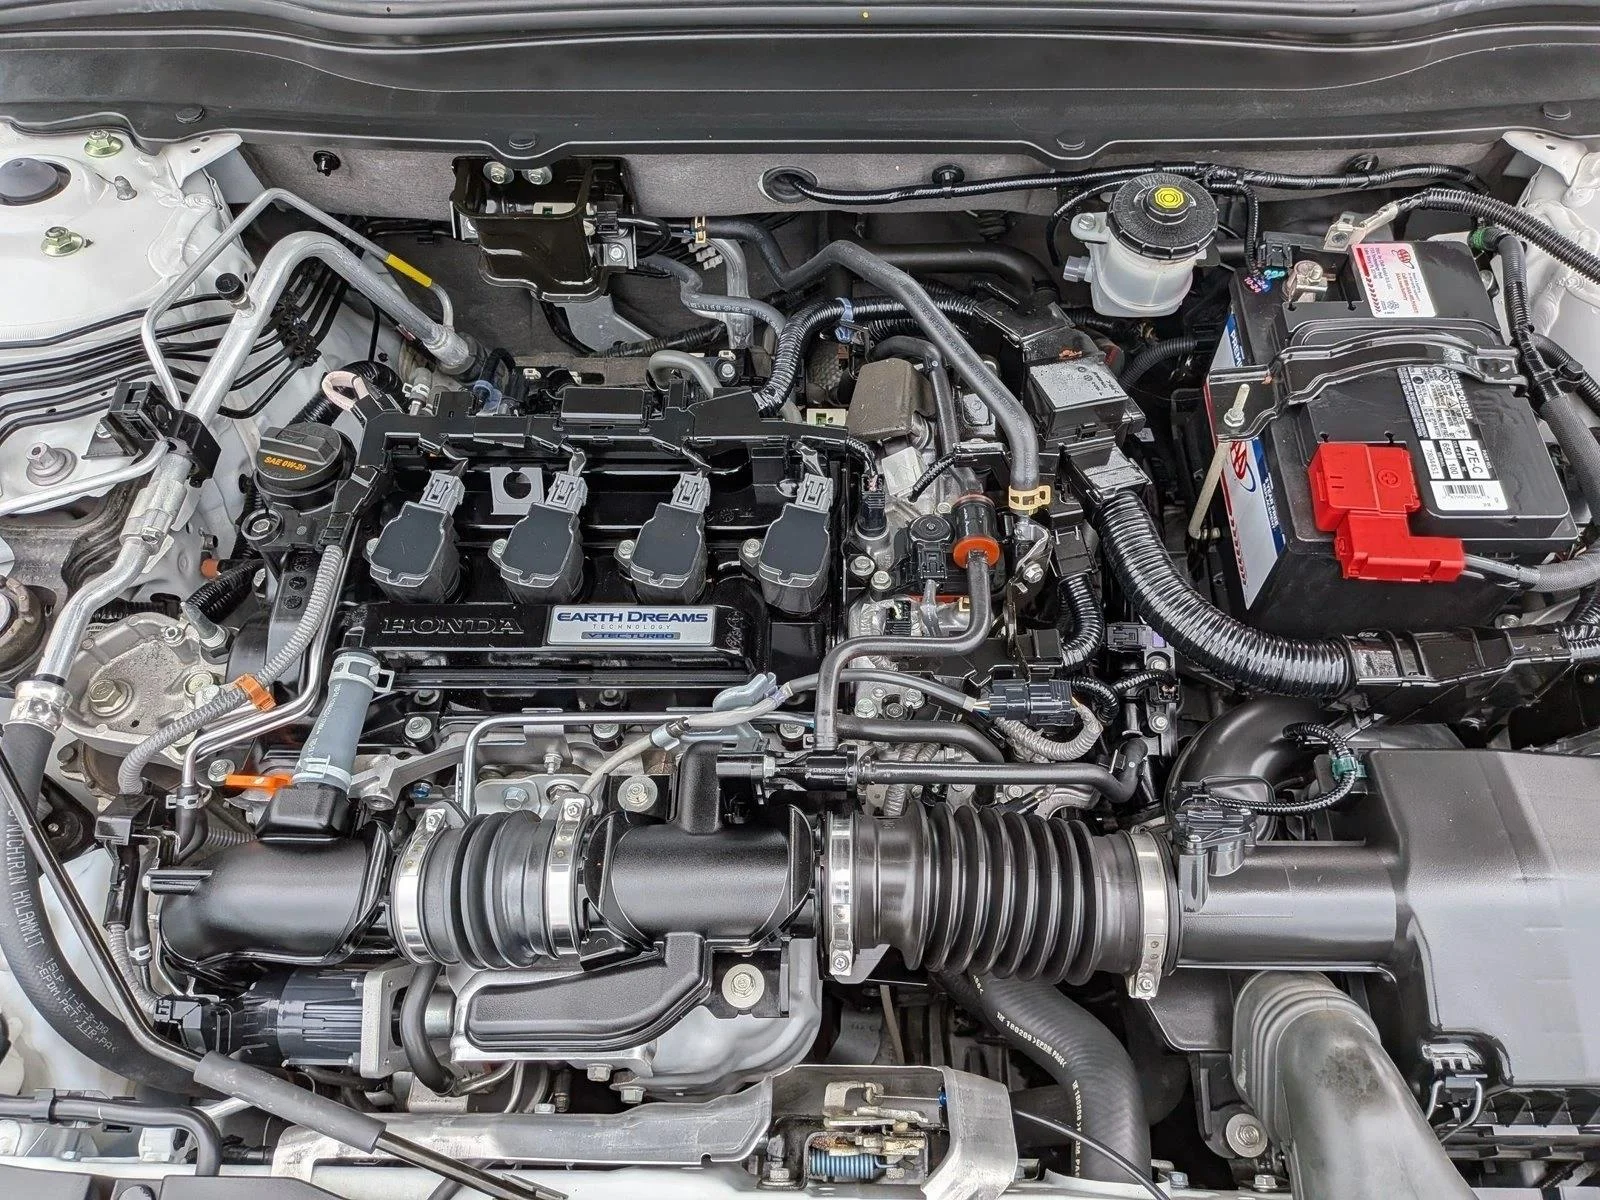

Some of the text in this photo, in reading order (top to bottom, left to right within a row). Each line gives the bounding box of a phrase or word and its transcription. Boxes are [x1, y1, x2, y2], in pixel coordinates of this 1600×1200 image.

[1442, 443, 1453, 456] 650
[264, 456, 307, 471] SAE 0W-20
[1464, 446, 1484, 473] 47E-C
[1448, 464, 1459, 475] 100
[381, 617, 525, 635] HONDA
[557, 611, 708, 623] EARTH DREAMS
[6, 823, 45, 949] NICHIRIN HYLAMMIT
[46, 957, 65, 982] 15LP
[1006, 1020, 1032, 1042] 180209
